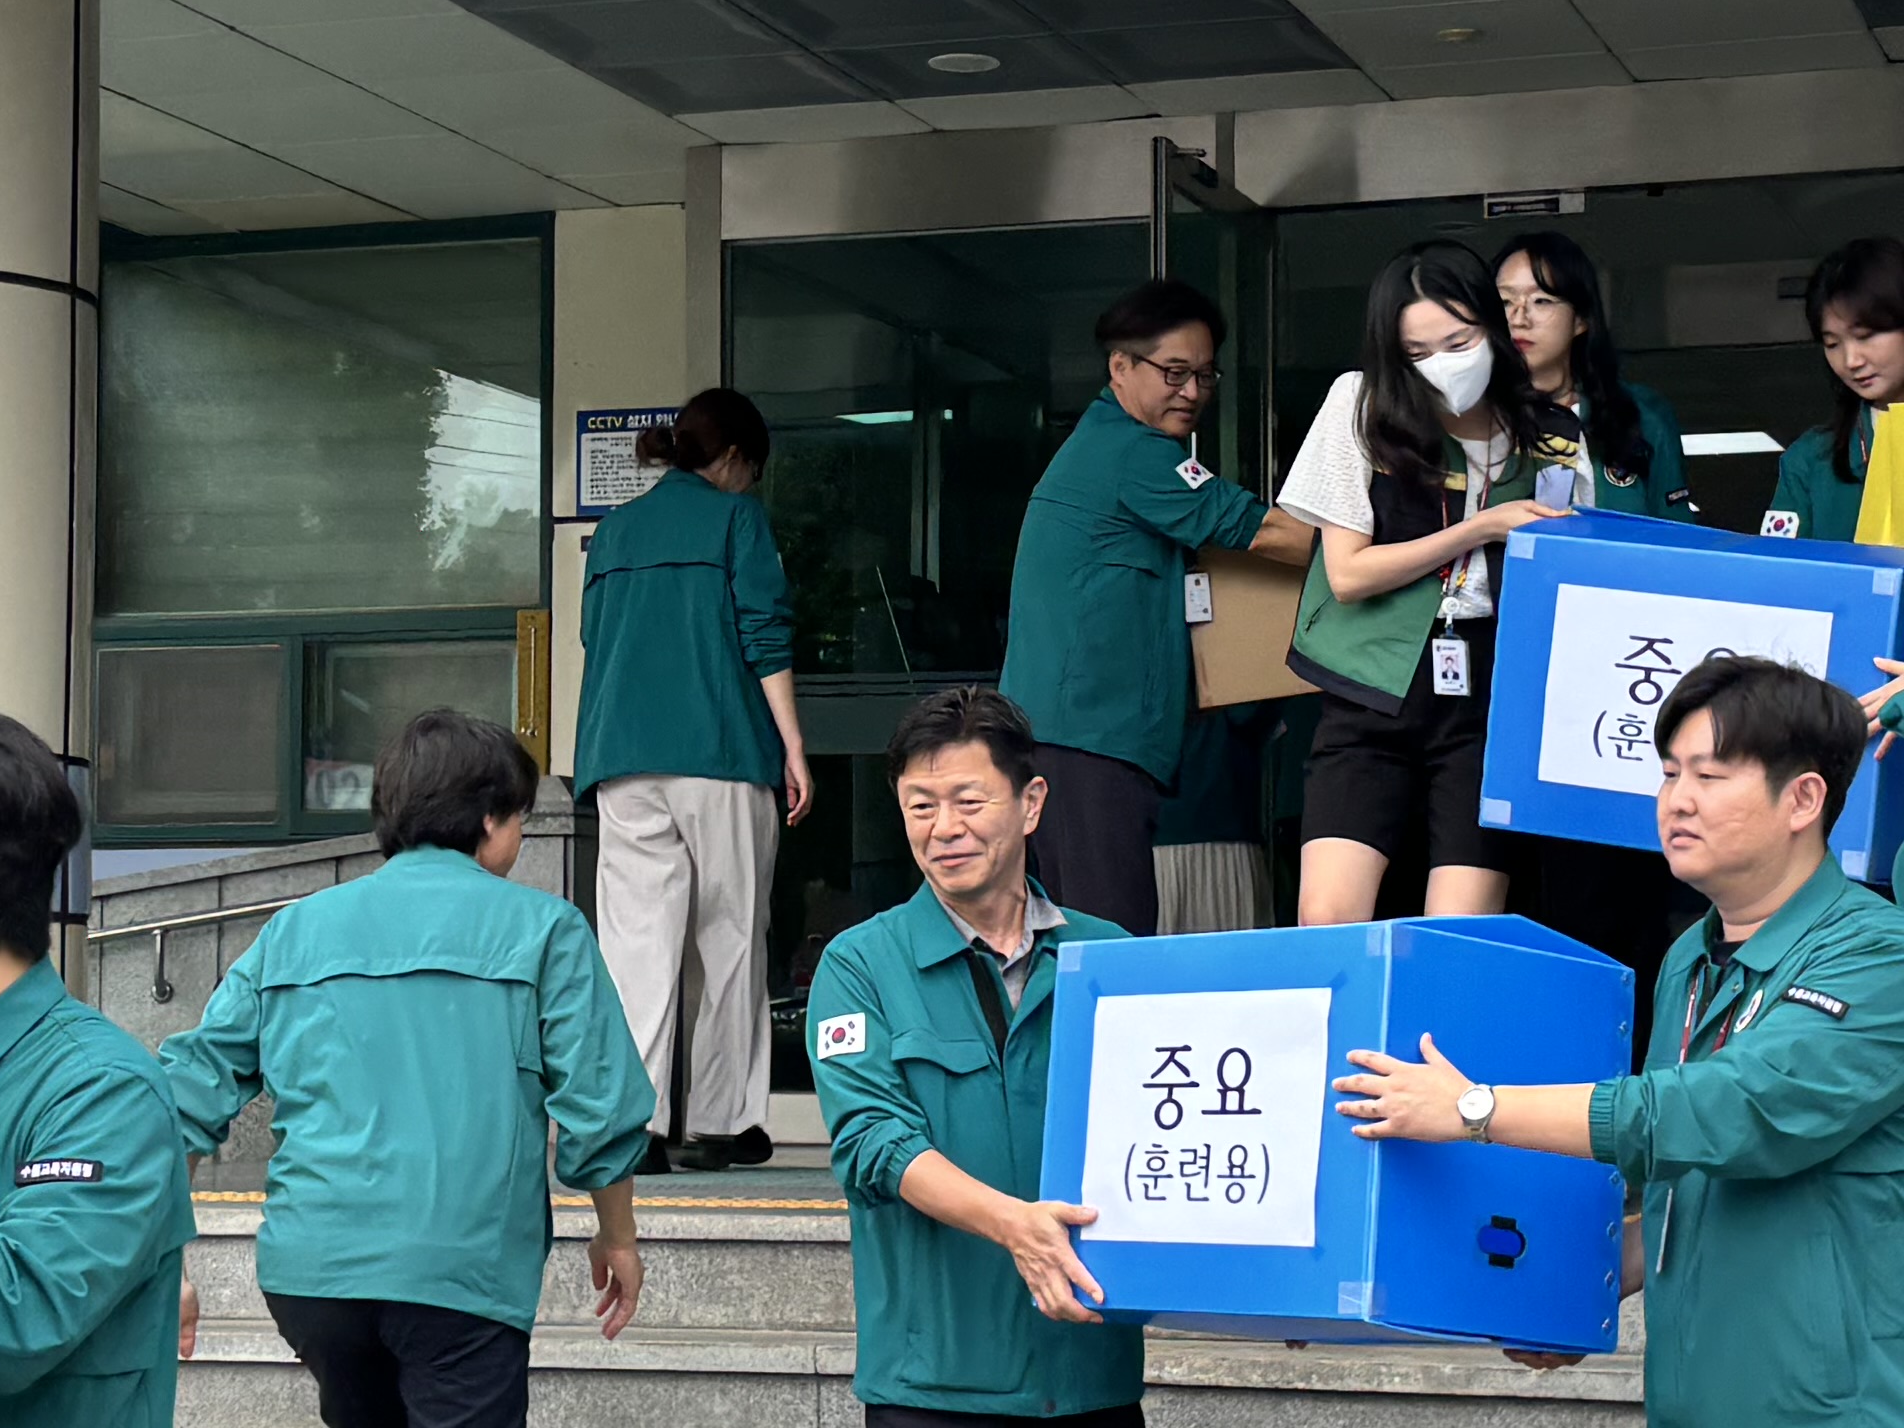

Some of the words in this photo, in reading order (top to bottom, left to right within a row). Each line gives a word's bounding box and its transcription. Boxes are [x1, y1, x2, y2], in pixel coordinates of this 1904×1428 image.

[587, 416, 623, 429] CCTV
[1614, 635, 1738, 706] 중
[1142, 1044, 1263, 1131] 중요
[1124, 1142, 1270, 1205] (훈련용)
